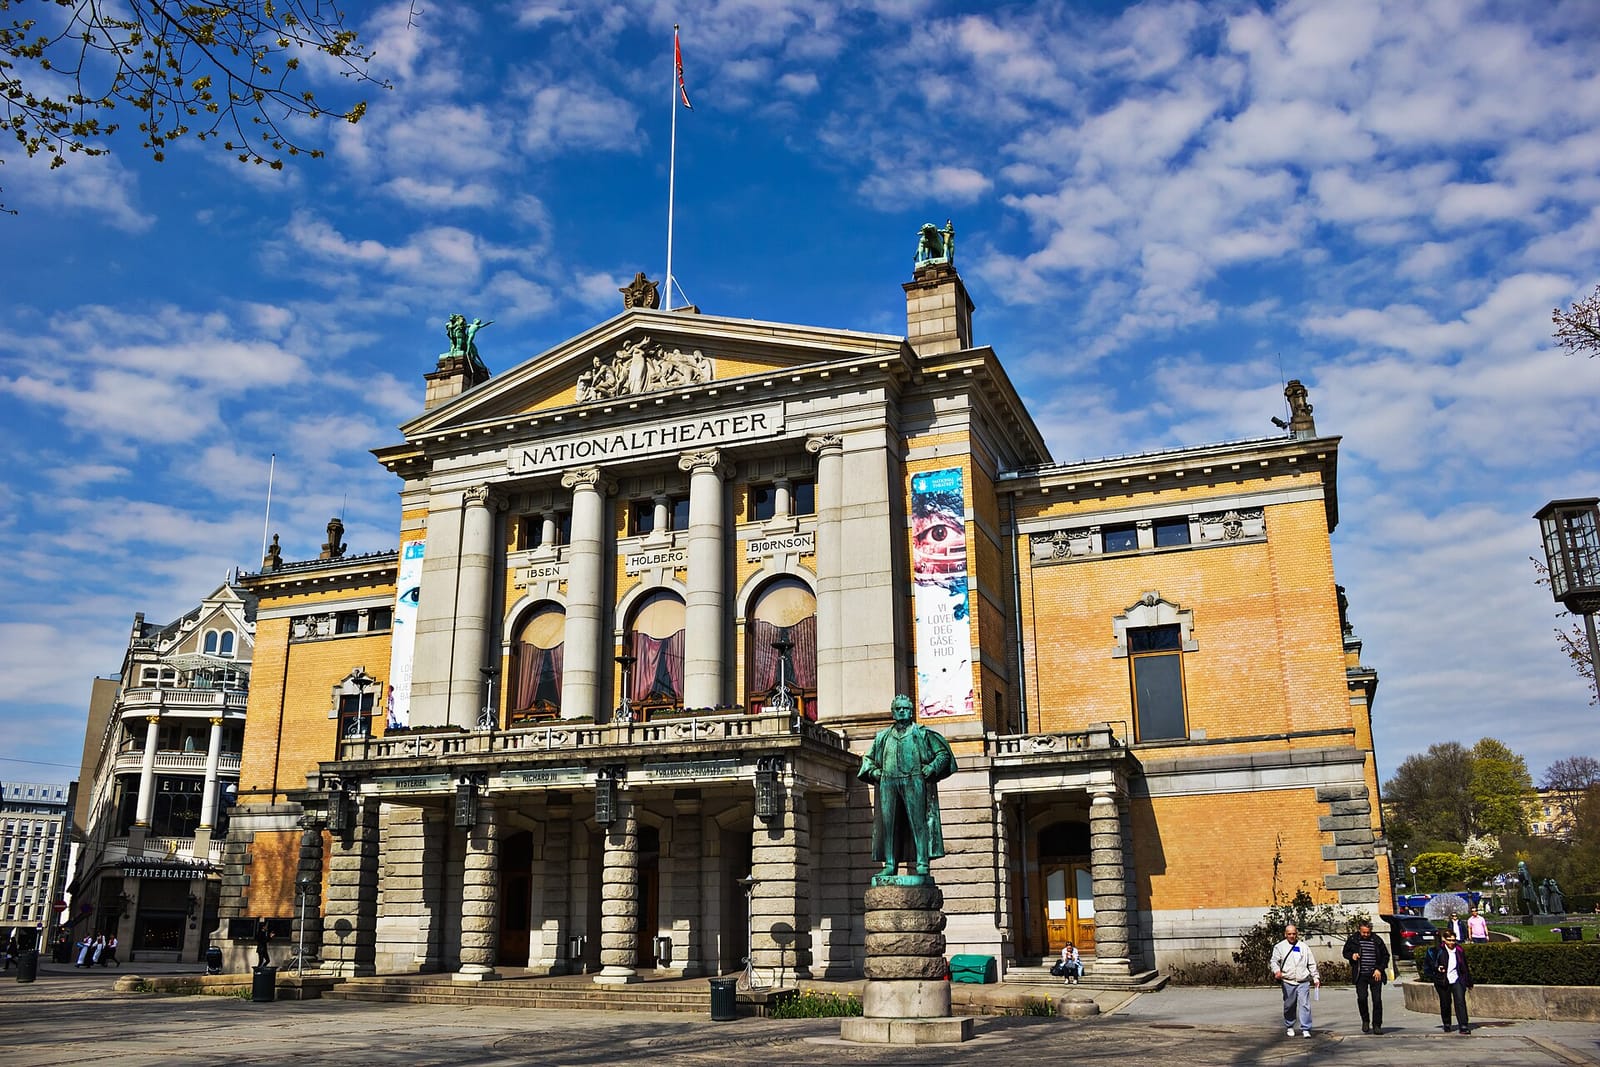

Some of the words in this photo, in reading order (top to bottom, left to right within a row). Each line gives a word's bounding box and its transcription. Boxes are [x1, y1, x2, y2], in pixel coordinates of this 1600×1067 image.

[522, 413, 767, 466] NATIONALTHEATER
[751, 537, 810, 553] BJØRNSON
[631, 552, 683, 566] HOLBERG
[527, 567, 560, 579] IBSEN
[937, 603, 947, 612] VI
[934, 624, 953, 635] DEG
[934, 646, 954, 657] HUD
[123, 868, 204, 879] THEATERCAFEEN
